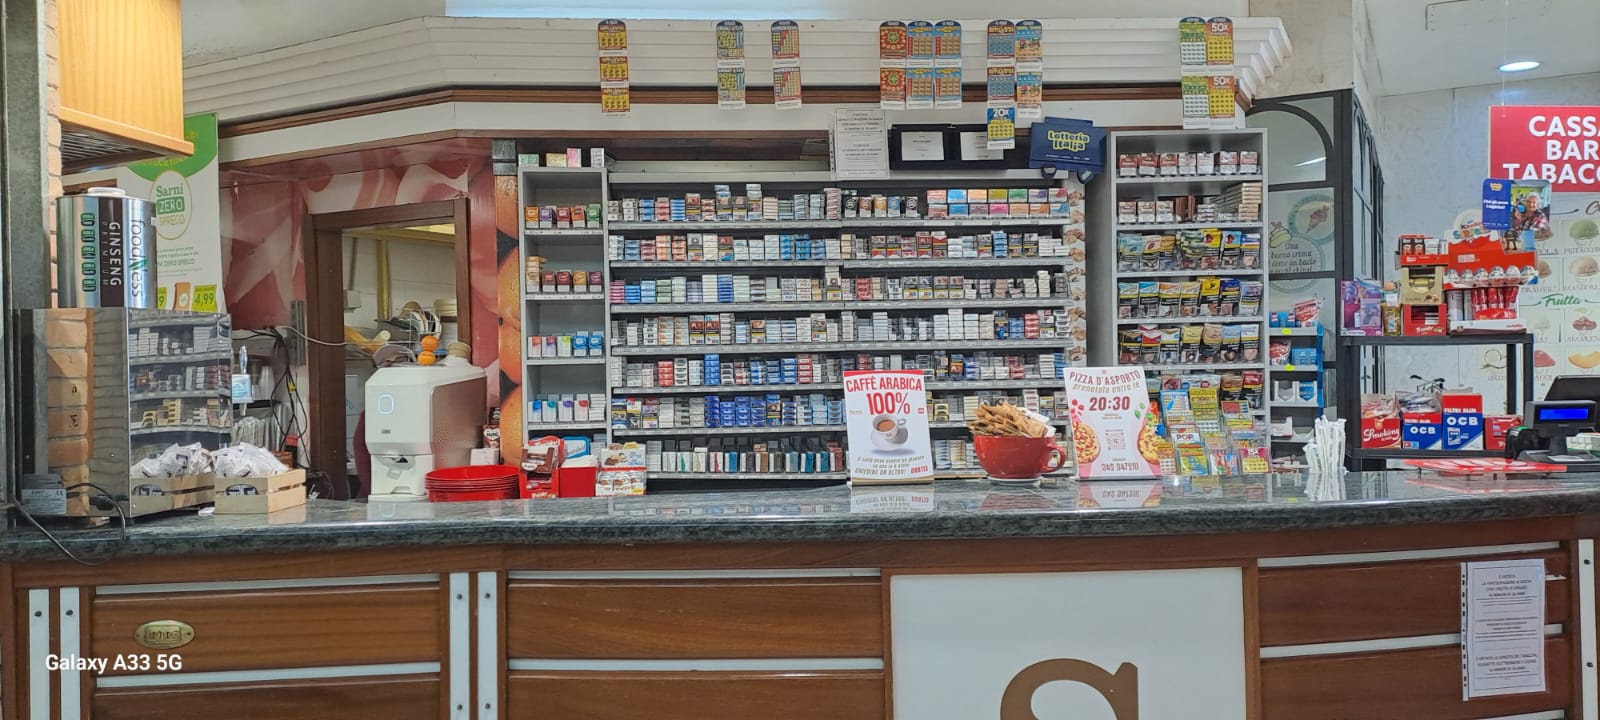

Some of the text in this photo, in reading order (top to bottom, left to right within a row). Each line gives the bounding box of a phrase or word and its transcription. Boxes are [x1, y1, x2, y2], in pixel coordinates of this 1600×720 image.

[1529, 116, 1600, 137] CASS
[1049, 132, 1089, 143] Lotteria
[1054, 141, 1084, 150] Italia
[1546, 140, 1600, 160] BAR
[1503, 163, 1600, 184] TABAC
[156, 184, 184, 197] Sarni
[160, 199, 183, 212] ZERO
[109, 222, 122, 286] GINSENG
[194, 293, 214, 306] 4,99
[1541, 293, 1582, 307] Frutta
[846, 376, 922, 392] CAFFÈ ARABICA
[1069, 369, 1142, 386] PIZZA D'ASPORTO
[867, 392, 910, 415] 100%
[1089, 396, 1131, 411] 20:30
[1446, 417, 1479, 425] OCB
[1363, 428, 1400, 442] Smoking
[1410, 426, 1436, 434] OCB
[911, 466, 928, 474] GRATIS
